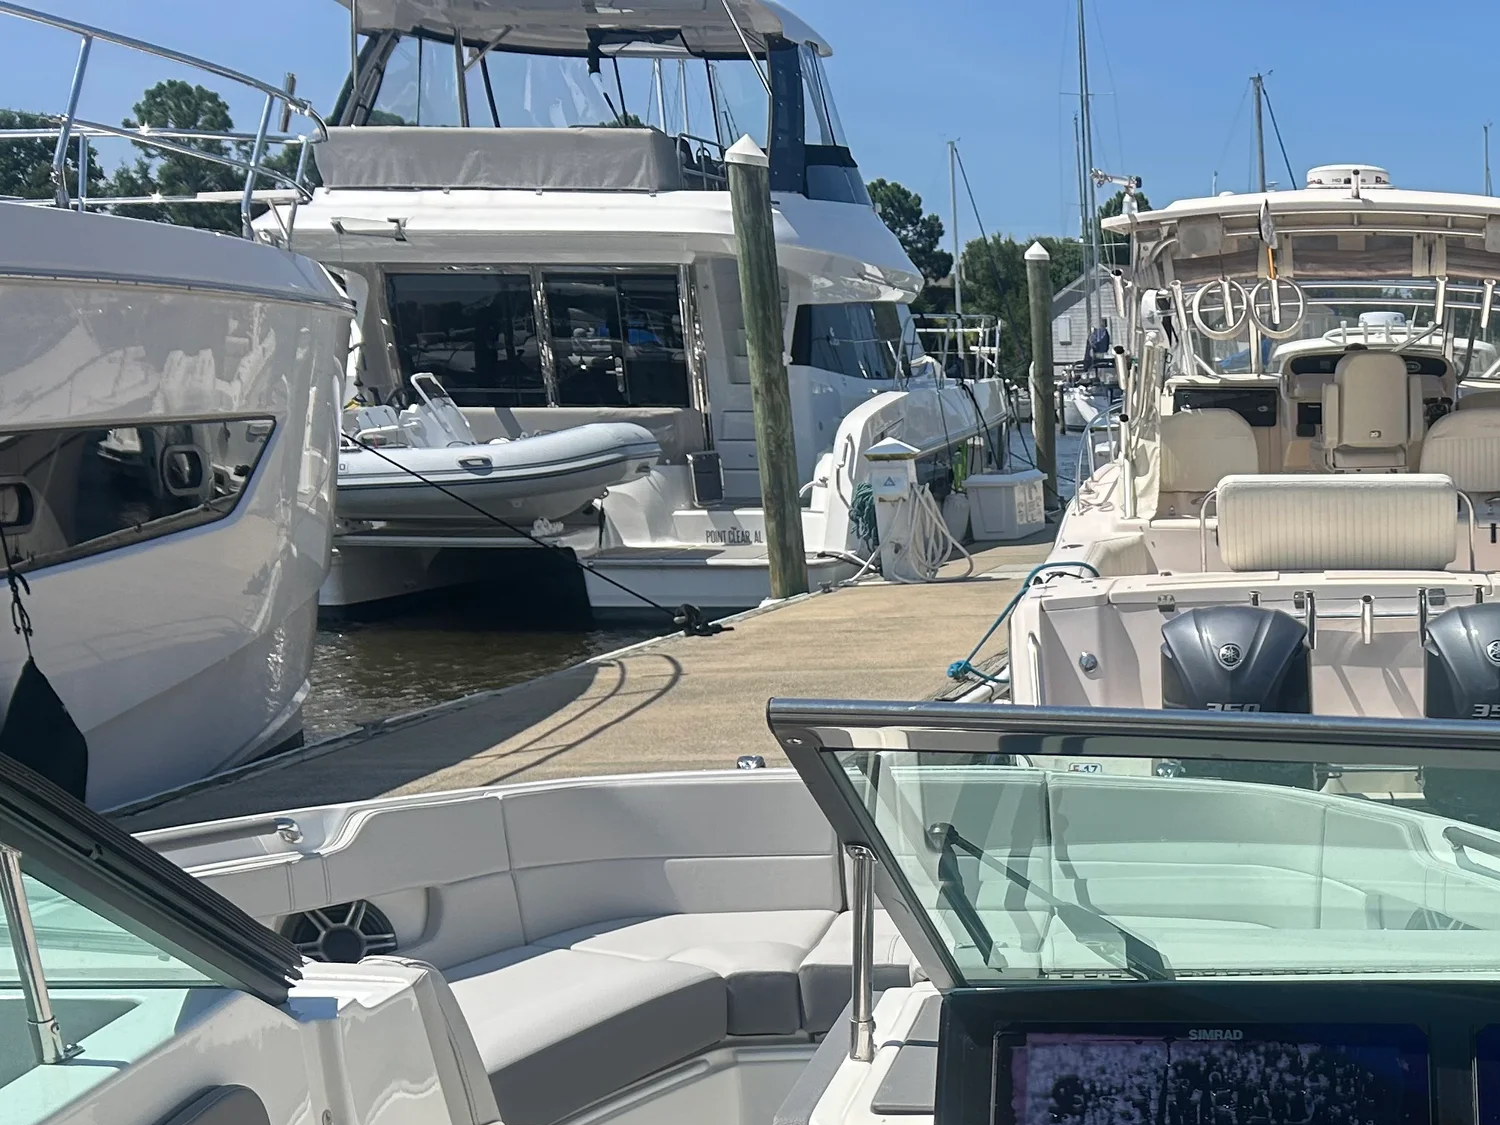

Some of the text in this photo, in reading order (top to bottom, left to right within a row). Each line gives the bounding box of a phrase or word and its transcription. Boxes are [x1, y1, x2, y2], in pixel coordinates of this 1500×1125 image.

[705, 530, 726, 543] POINT
[754, 530, 763, 544] AL
[1188, 1029, 1244, 1040] SIMRAD
